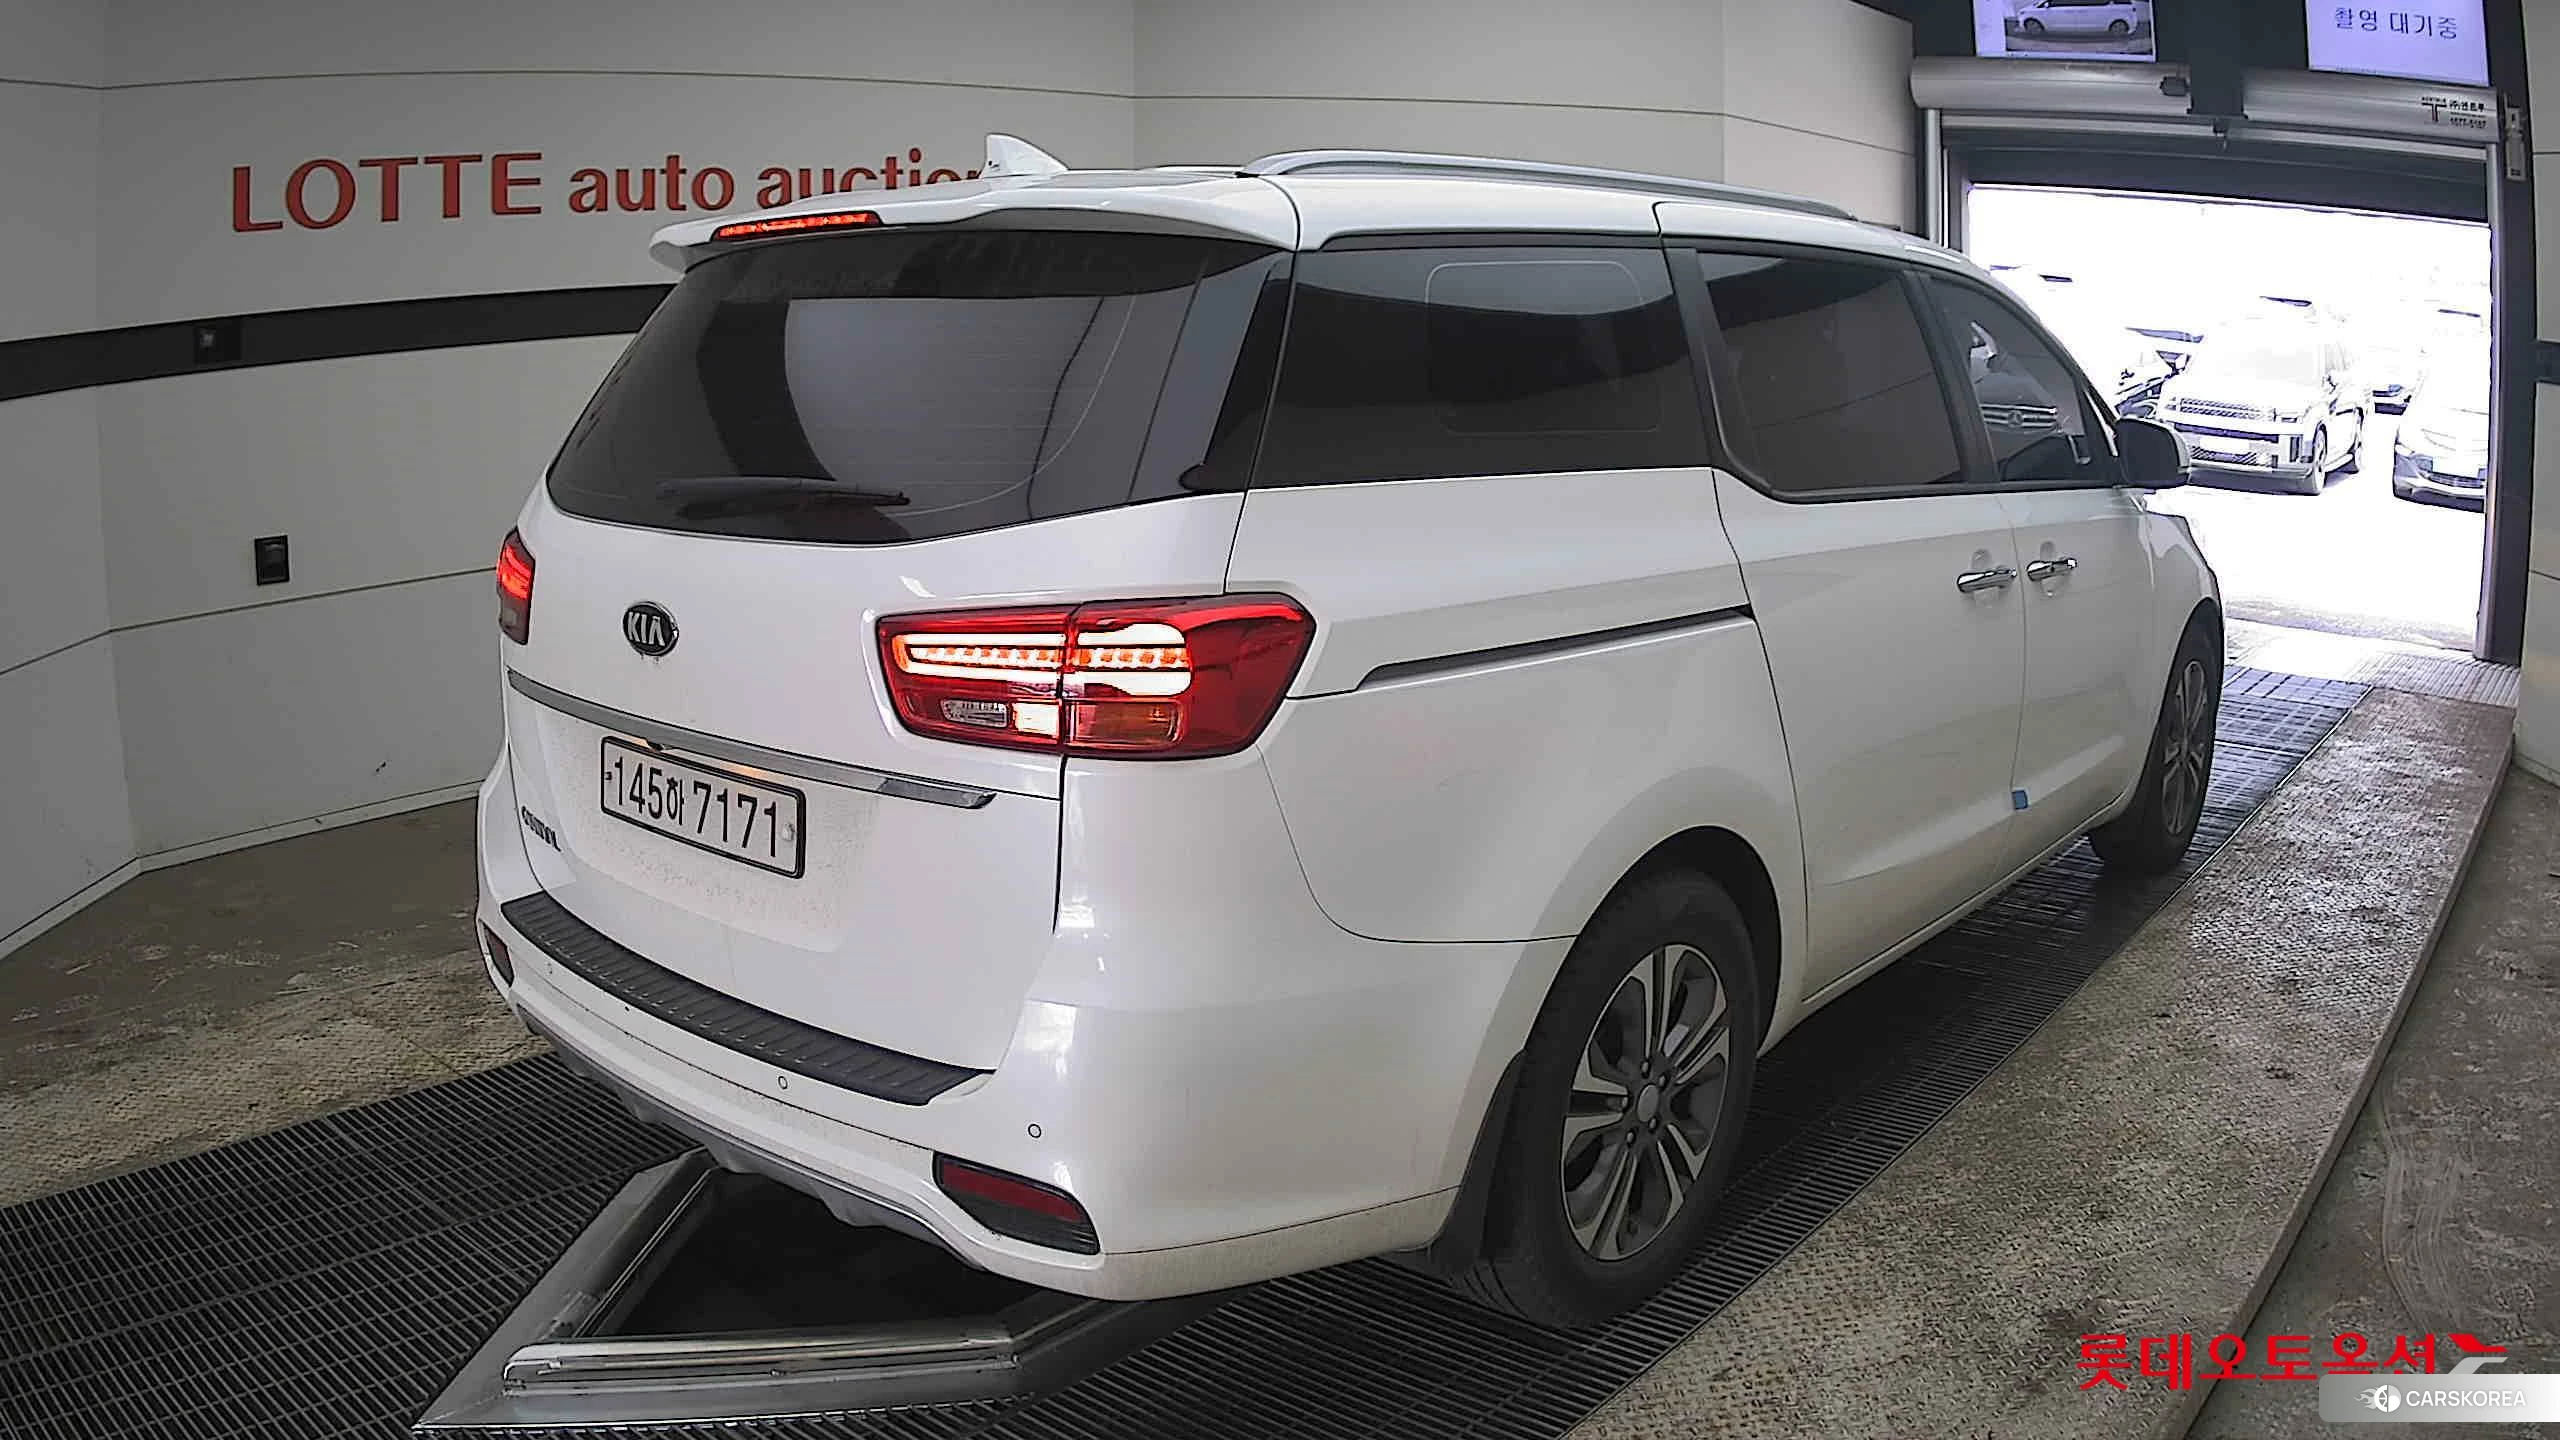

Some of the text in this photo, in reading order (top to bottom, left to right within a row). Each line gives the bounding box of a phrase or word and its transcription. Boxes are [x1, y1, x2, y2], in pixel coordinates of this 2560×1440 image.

[2335, 7, 2457, 40] 촬영 대기중
[232, 147, 984, 233] LOTTE auto aucti
[627, 611, 666, 647] KIA
